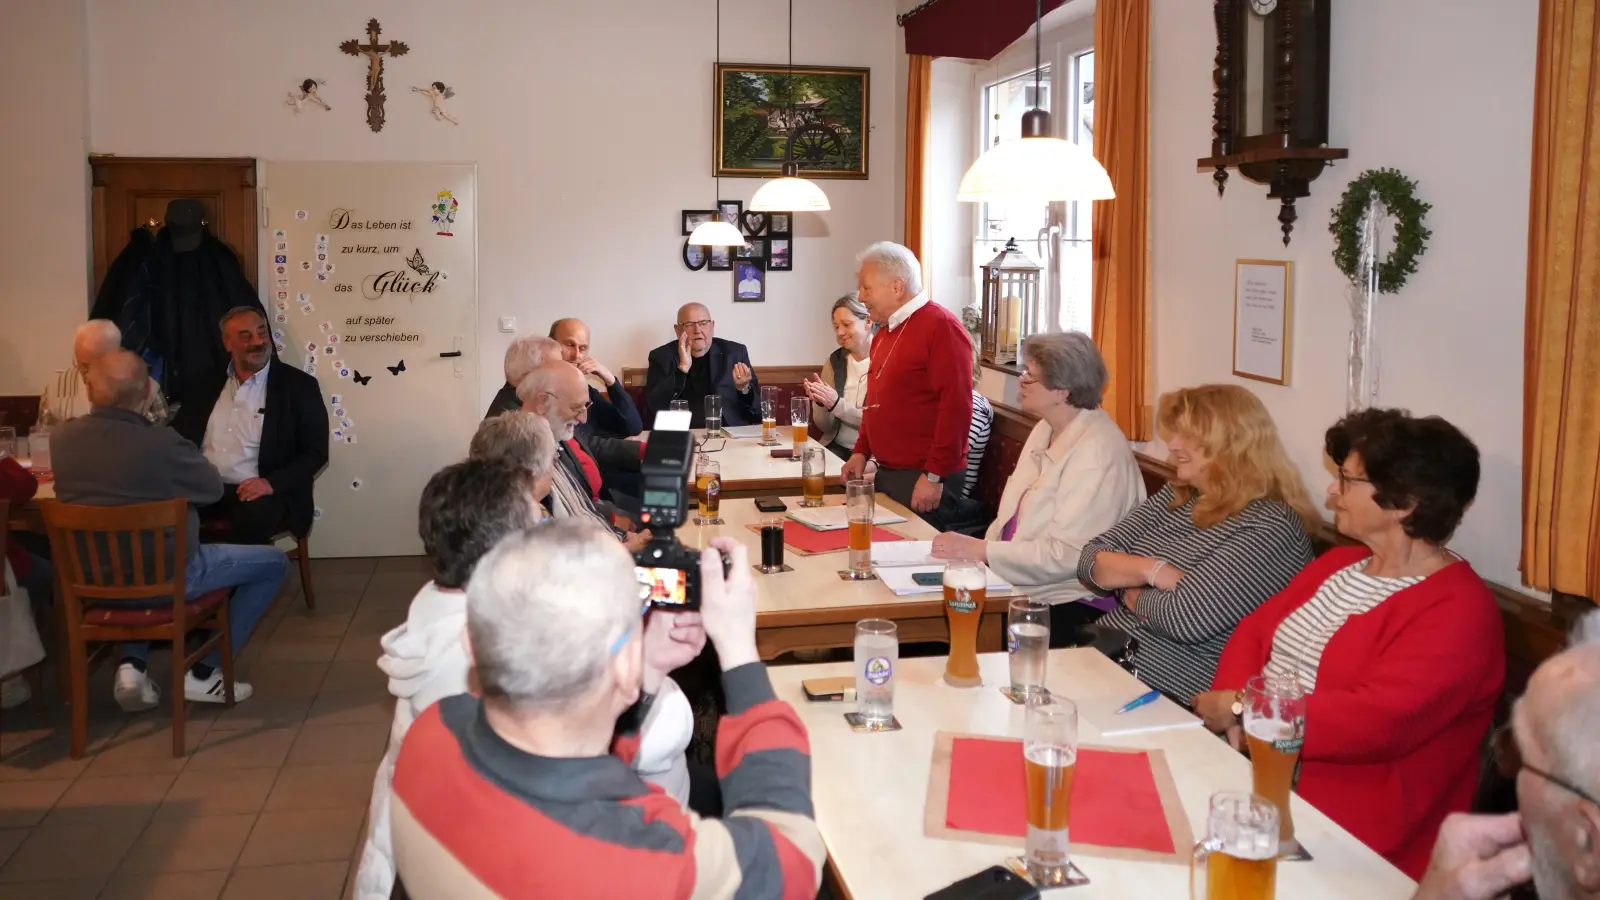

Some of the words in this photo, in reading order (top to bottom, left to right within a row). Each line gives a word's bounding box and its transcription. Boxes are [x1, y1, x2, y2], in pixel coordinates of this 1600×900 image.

[329, 207, 363, 230] Das
[365, 220, 397, 230] Leben
[399, 220, 412, 230] ist
[341, 246, 354, 254] zu
[356, 244, 380, 254] kurz,
[383, 246, 399, 254] um
[334, 283, 353, 292] das
[362, 270, 440, 301] Glück
[345, 315, 362, 325] auf
[364, 316, 395, 327] später
[344, 334, 357, 342] zu
[359, 332, 419, 342] verschieben
